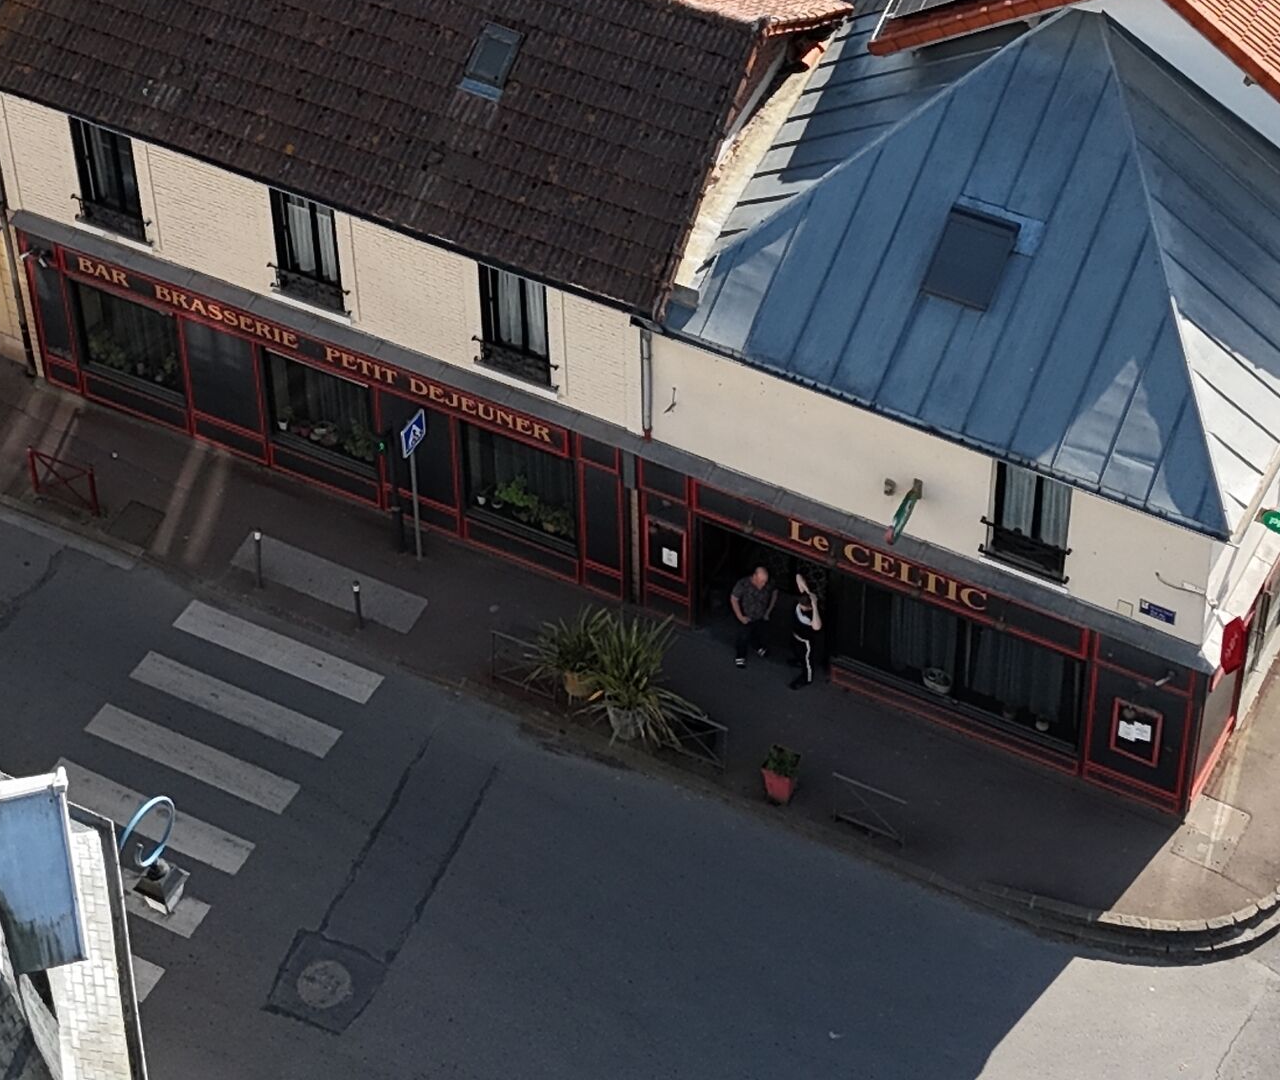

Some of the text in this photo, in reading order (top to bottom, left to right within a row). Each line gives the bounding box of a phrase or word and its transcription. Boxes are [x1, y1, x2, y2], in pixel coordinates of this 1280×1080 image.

[77, 256, 554, 443] BAR BRASSERIE PETIT DEJEUNER
[789, 519, 988, 610] Le CELTIC
